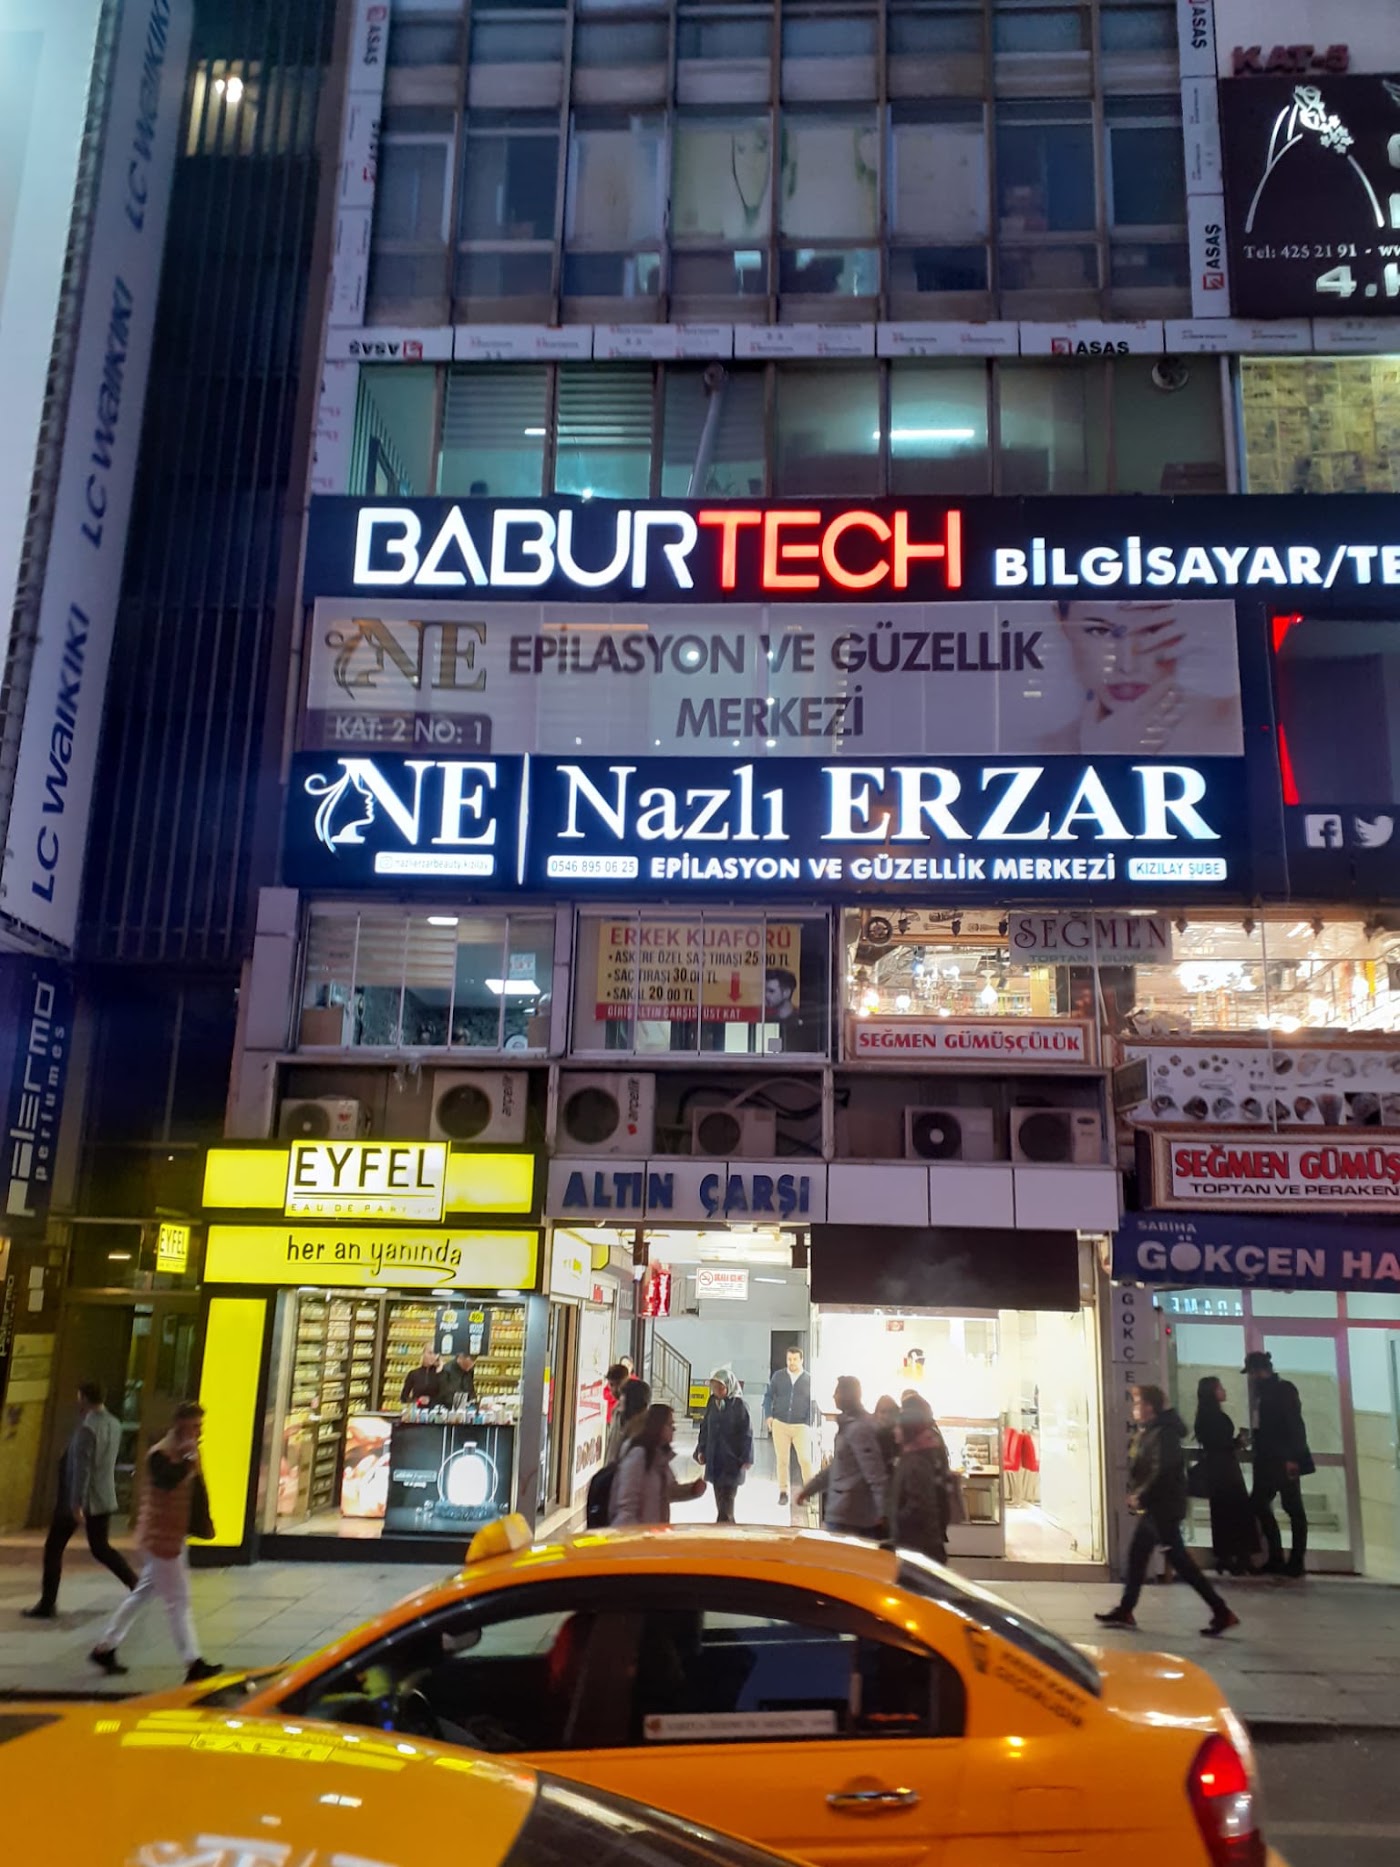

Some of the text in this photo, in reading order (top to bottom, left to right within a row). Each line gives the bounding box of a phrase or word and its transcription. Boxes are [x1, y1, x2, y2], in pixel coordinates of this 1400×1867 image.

[1244, 246, 1276, 258] Tel:
[1337, 244, 1357, 257] 91
[81, 474, 107, 548] LC
[508, 620, 1044, 674] EPİLASYON VE GÜZELLİK
[676, 685, 864, 738] MERKEZİ
[335, 716, 483, 743] KAT: 2 NO: 1
[556, 763, 1222, 842] Nazlı ERZAR
[32, 826, 60, 903] LC
[551, 860, 635, 873] 0546 895 06 25
[650, 853, 1116, 880] EPİLASYON VE GÜZELLİK MERKEZİ
[1136, 863, 1184, 875] KIZILAY
[611, 927, 680, 947] ERKEK
[859, 1029, 1080, 1053] SEĞMEN GÜMÜŞÇÜLÜK
[34, 1027, 66, 1181] perfumes
[294, 1147, 436, 1188] EYFEL
[1175, 1145, 1290, 1179] SEĞMEN
[562, 1171, 810, 1218] ALTIN ÇARŞI
[1189, 1182, 1271, 1195] TOPTAN
[1275, 1184, 1300, 1195] VE
[291, 1203, 324, 1213] EAU
[334, 1204, 354, 1213] DE
[160, 1227, 187, 1255] EYFEL
[287, 1234, 463, 1277] her an yanında
[1137, 1235, 1325, 1281] GÖKÇEN
